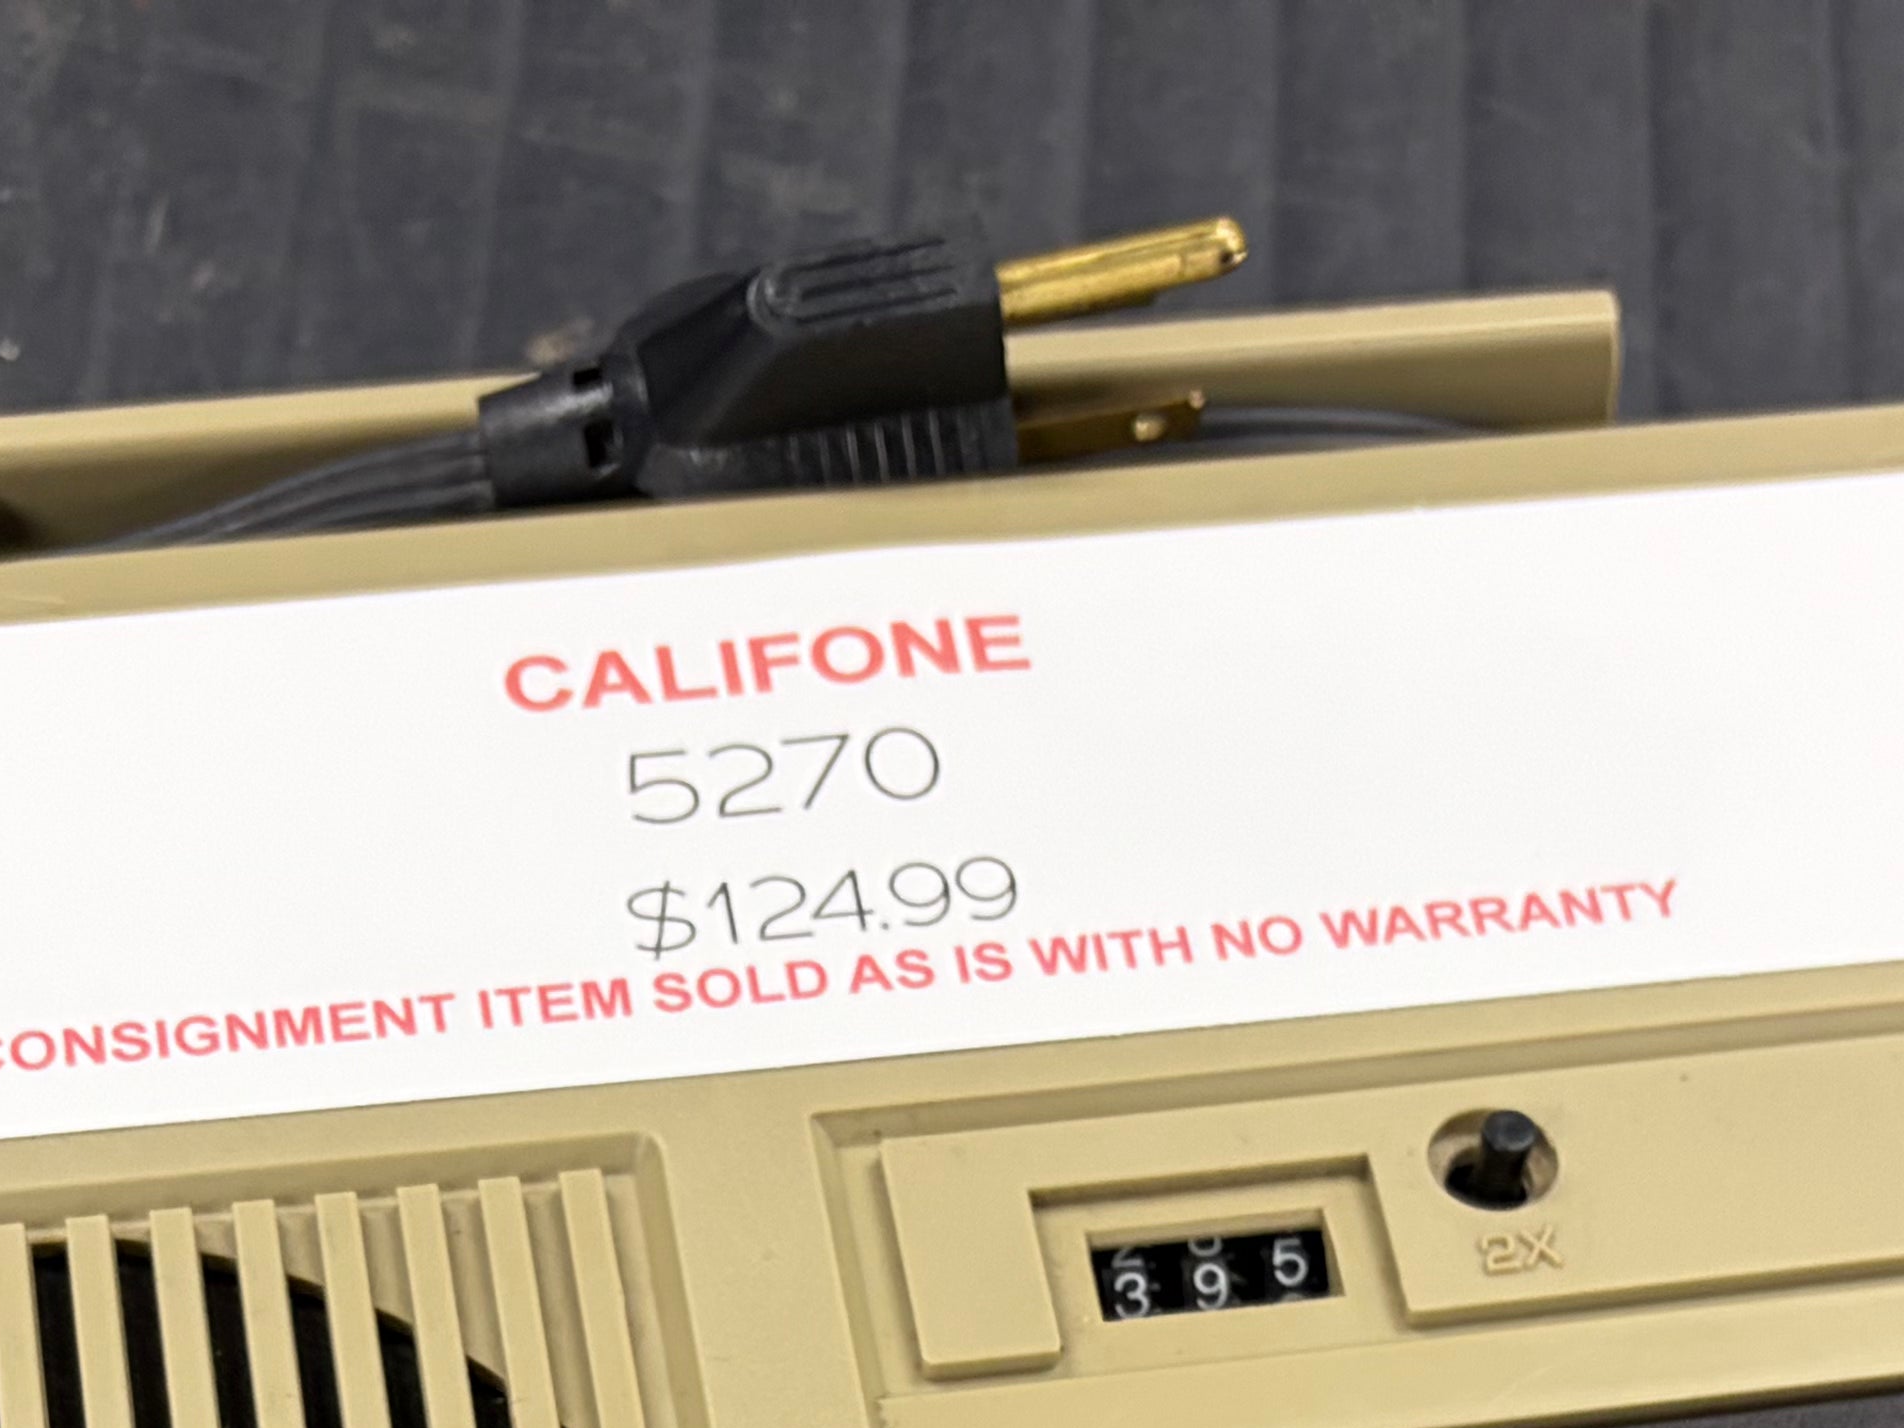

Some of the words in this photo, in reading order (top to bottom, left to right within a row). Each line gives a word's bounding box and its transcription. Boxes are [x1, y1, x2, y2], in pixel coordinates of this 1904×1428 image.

[504, 614, 1032, 714] CALIFONE
[628, 727, 941, 825] 5270
[478, 978, 633, 1029] ITEM
[653, 960, 829, 1013] SOLD
[850, 949, 936, 994] AS
[954, 942, 1014, 984] IS
[1029, 925, 1194, 976] WITH
[1211, 916, 1303, 960] NO
[1320, 880, 1676, 949] WARRANTY
[626, 856, 1018, 961] $124.99
[1478, 1223, 1564, 1275] 2X
